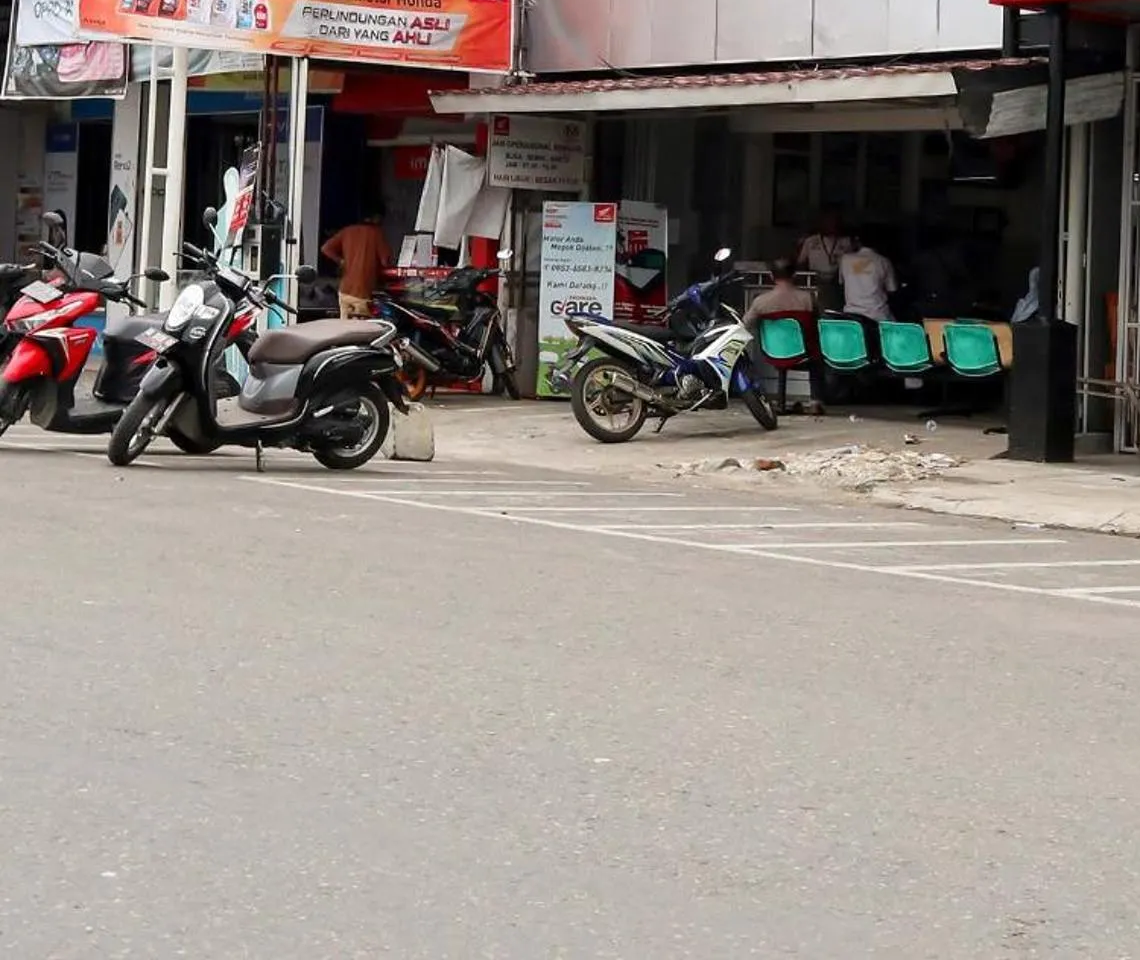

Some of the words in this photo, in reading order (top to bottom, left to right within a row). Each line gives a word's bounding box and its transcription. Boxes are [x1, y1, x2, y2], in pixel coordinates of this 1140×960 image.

[302, 6, 408, 28] PERLINDUNGAN
[410, 16, 450, 31] ASLI
[319, 24, 351, 39] DARI
[354, 27, 389, 42] YANG
[392, 30, 432, 46] AHLI
